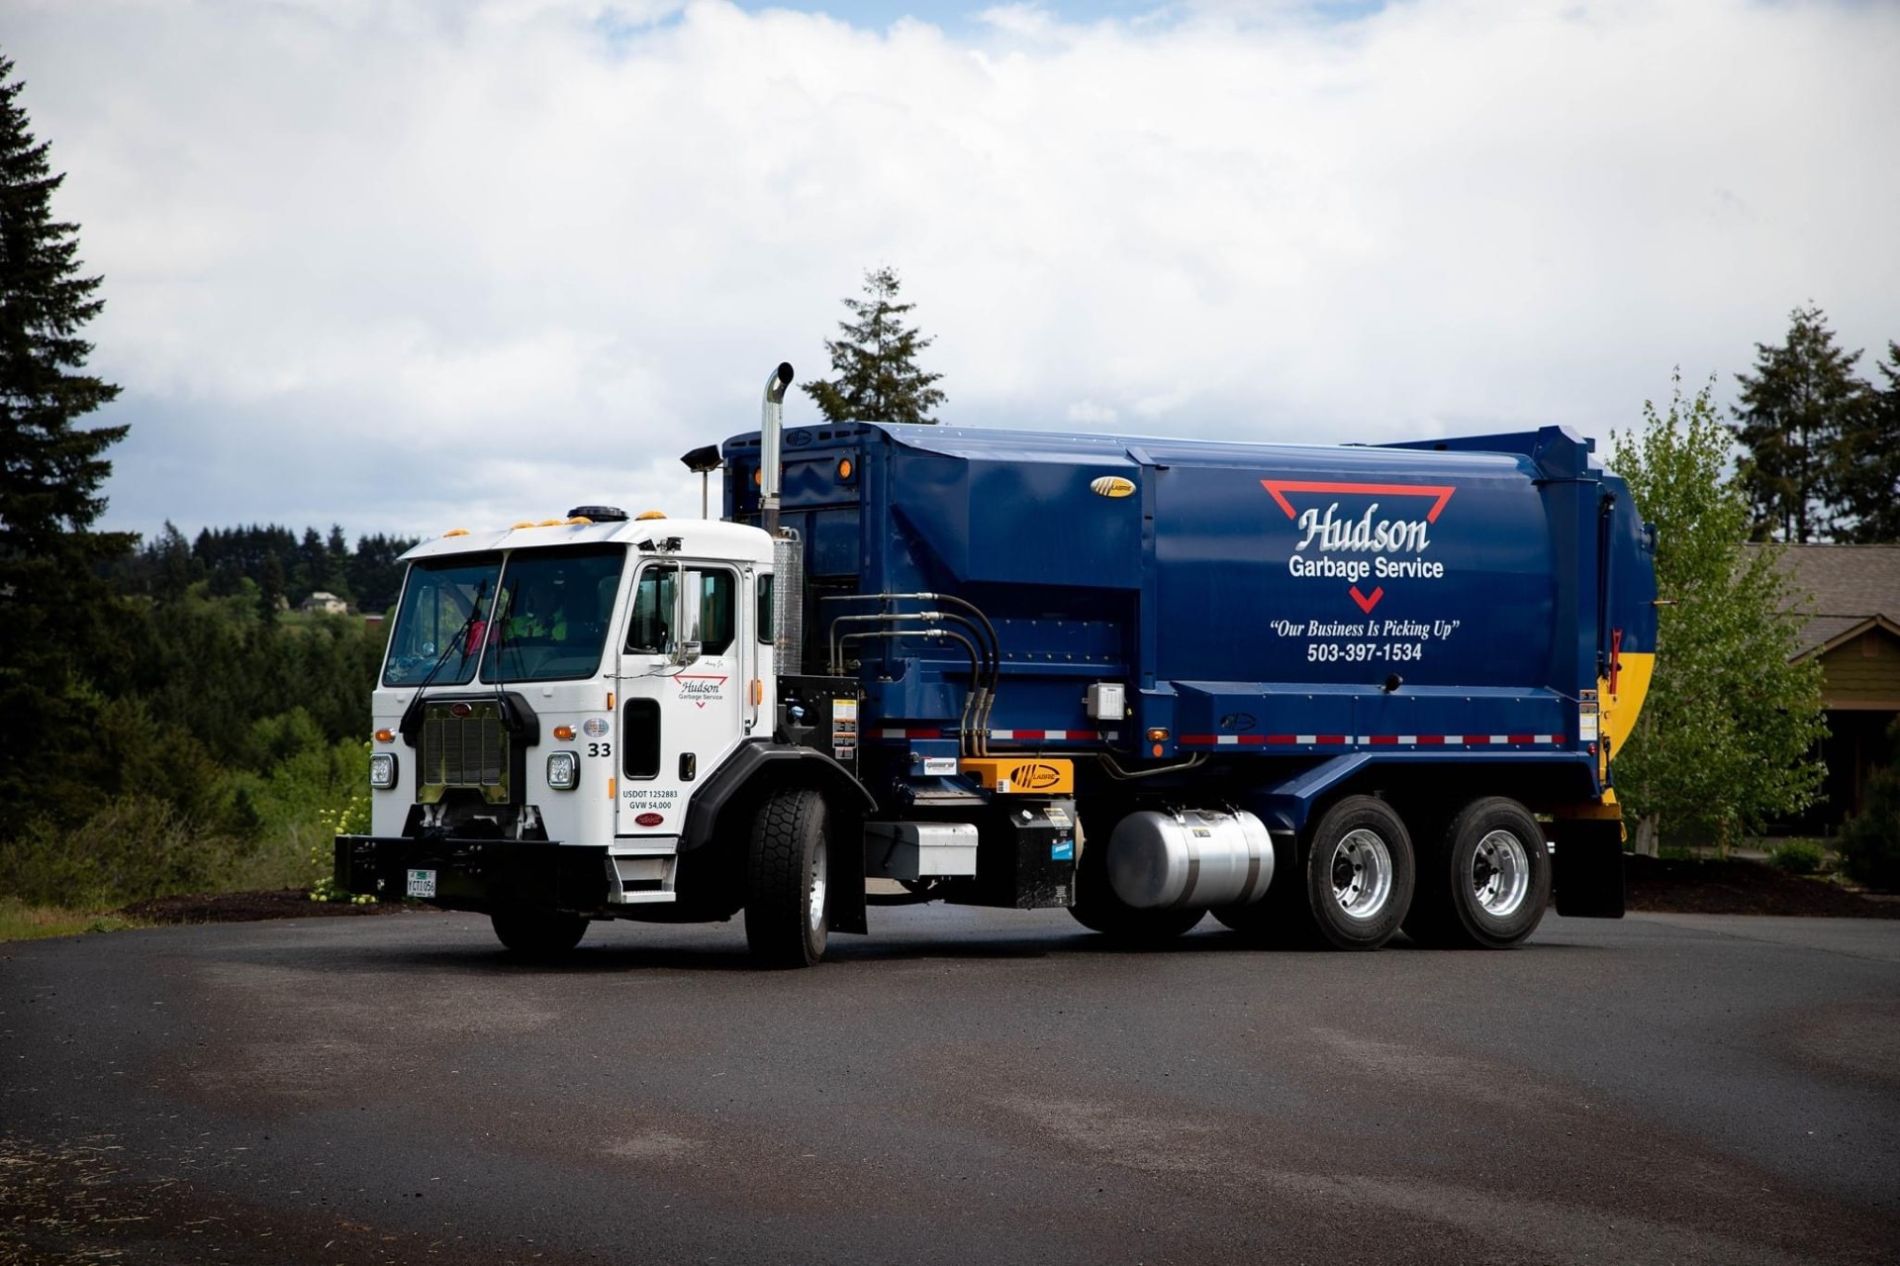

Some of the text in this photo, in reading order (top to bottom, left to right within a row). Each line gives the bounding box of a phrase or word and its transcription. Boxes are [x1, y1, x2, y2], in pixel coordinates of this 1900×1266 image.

[1296, 502, 1430, 553] Hudson
[1289, 555, 1444, 582] Garbage Service
[1307, 620, 1364, 637] Business
[1367, 620, 1379, 637] Is
[1382, 620, 1430, 640] Picking
[1307, 643, 1422, 662] 503-397-1534
[681, 680, 720, 693] Hudson
[588, 743, 611, 757] 33
[622, 790, 678, 798] USDOT 1252883
[629, 801, 647, 809] GVW
